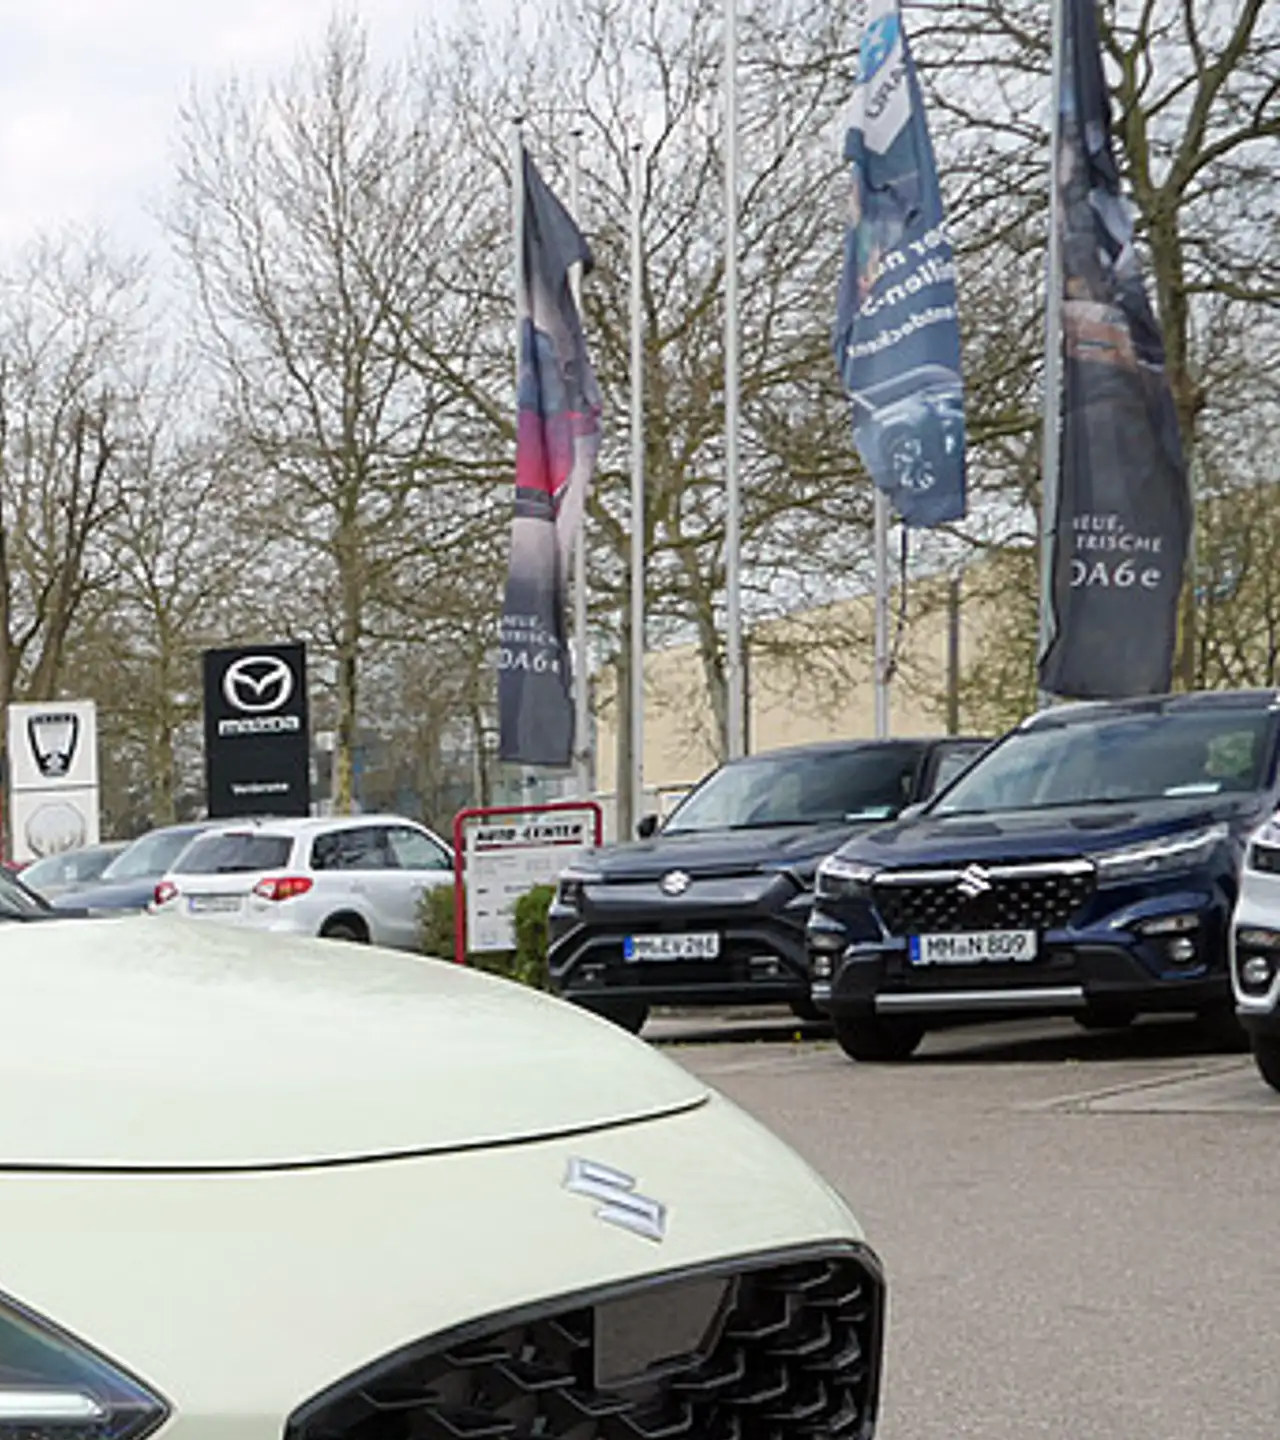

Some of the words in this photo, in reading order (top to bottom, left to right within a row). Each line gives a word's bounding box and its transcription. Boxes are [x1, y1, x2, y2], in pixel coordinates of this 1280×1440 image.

[927, 937, 955, 957] MM
[968, 936, 982, 955] N
[987, 934, 1027, 954] 809
